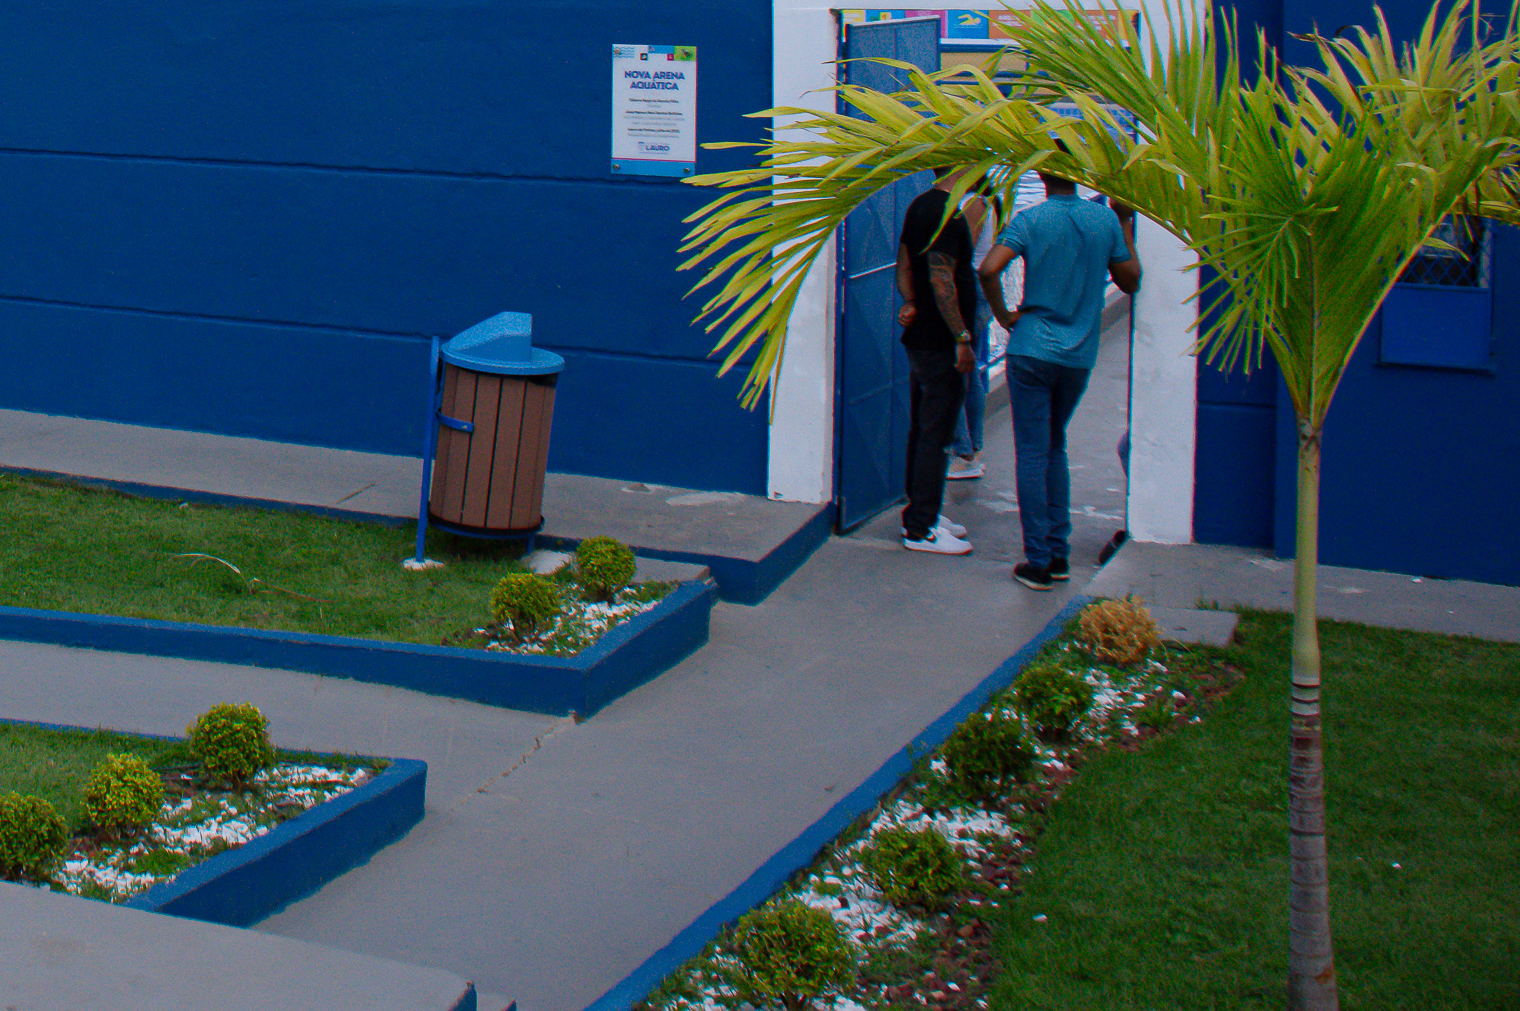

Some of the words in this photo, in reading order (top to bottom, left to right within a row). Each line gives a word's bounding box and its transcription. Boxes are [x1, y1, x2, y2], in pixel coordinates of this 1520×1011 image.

[624, 70, 651, 80] NOVA
[652, 71, 685, 81] ARENA
[645, 144, 670, 152] LAURO
